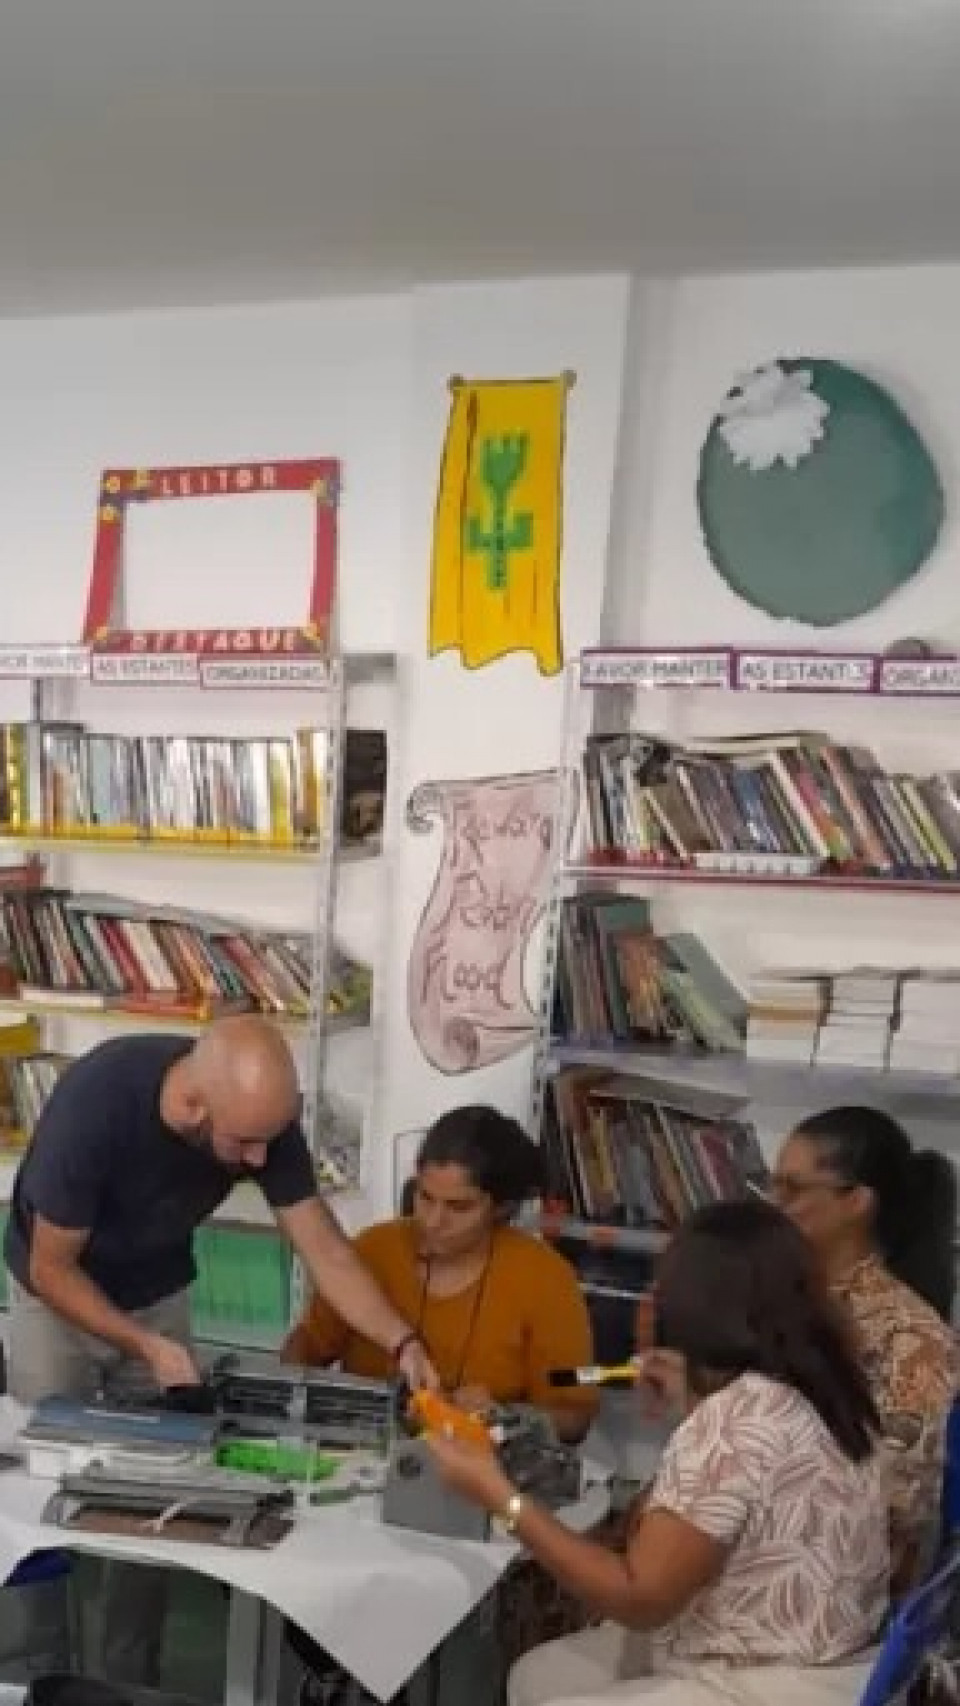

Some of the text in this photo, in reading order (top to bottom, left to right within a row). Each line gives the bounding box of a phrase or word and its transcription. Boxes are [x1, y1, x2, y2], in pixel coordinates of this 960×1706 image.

[160, 465, 278, 496] LEITOR
[585, 659, 646, 677] FAVOR
[651, 657, 729, 677] MANTER
[742, 661, 768, 681] AS
